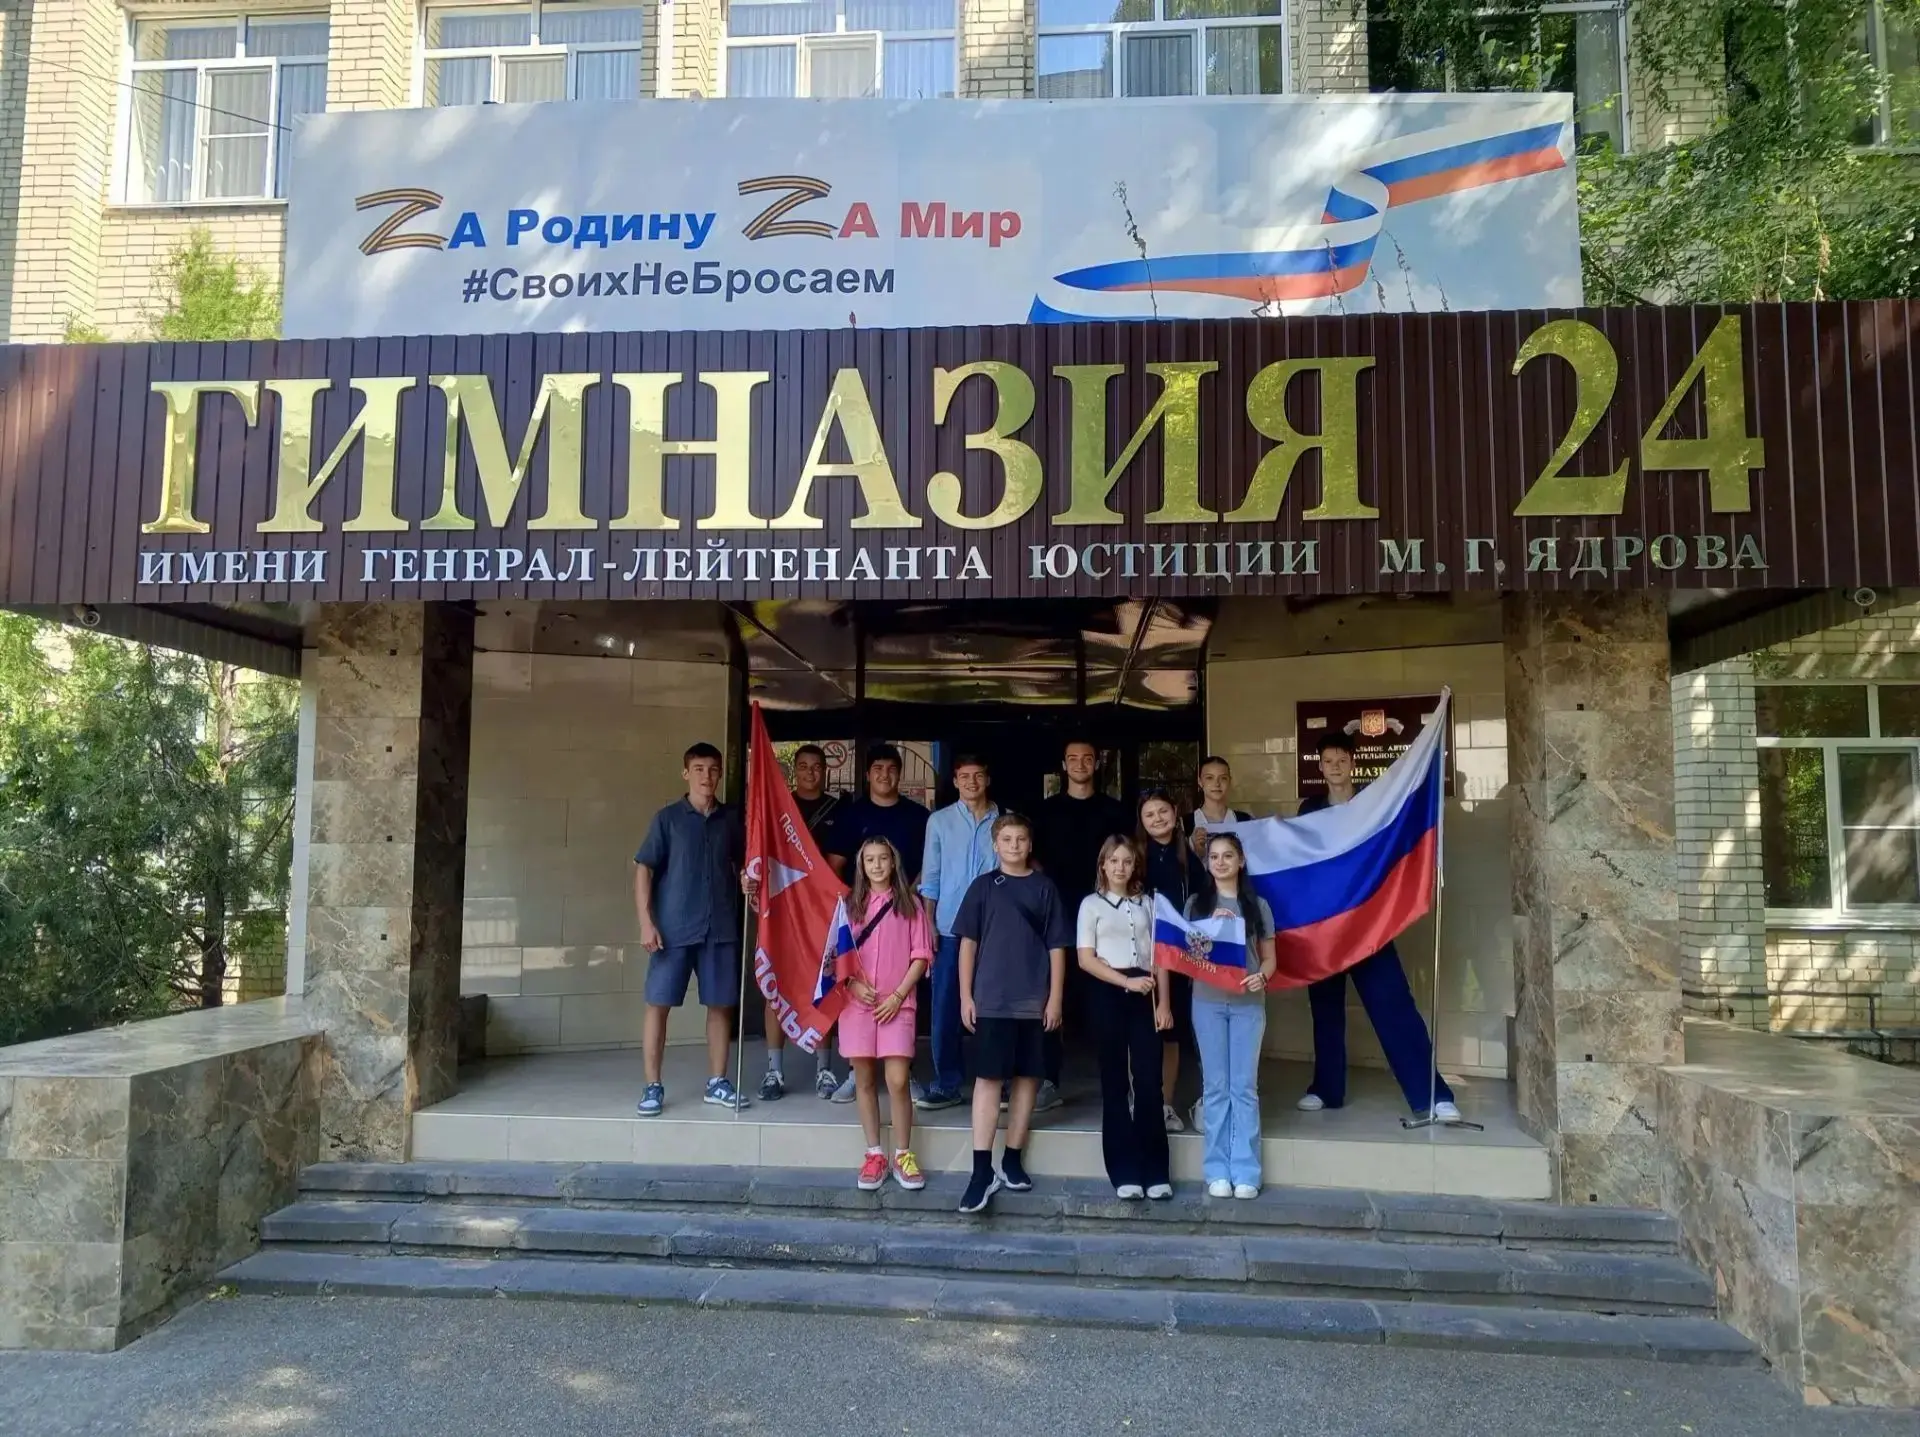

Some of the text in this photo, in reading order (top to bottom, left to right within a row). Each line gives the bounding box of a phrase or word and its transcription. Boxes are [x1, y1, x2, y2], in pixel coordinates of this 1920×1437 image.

[505, 207, 716, 250] Родину
[899, 201, 1022, 248] Мир
[462, 261, 895, 303] #СвоихНеБросаем
[141, 315, 1766, 534] ГИМНАЗИЯ 24
[138, 533, 1770, 585] ИМЕНИ ГЕНЕРАЛ-ЛЕЙТЕНАНТА ЮСТИЦИИ М. Г. ЯДРОВА
